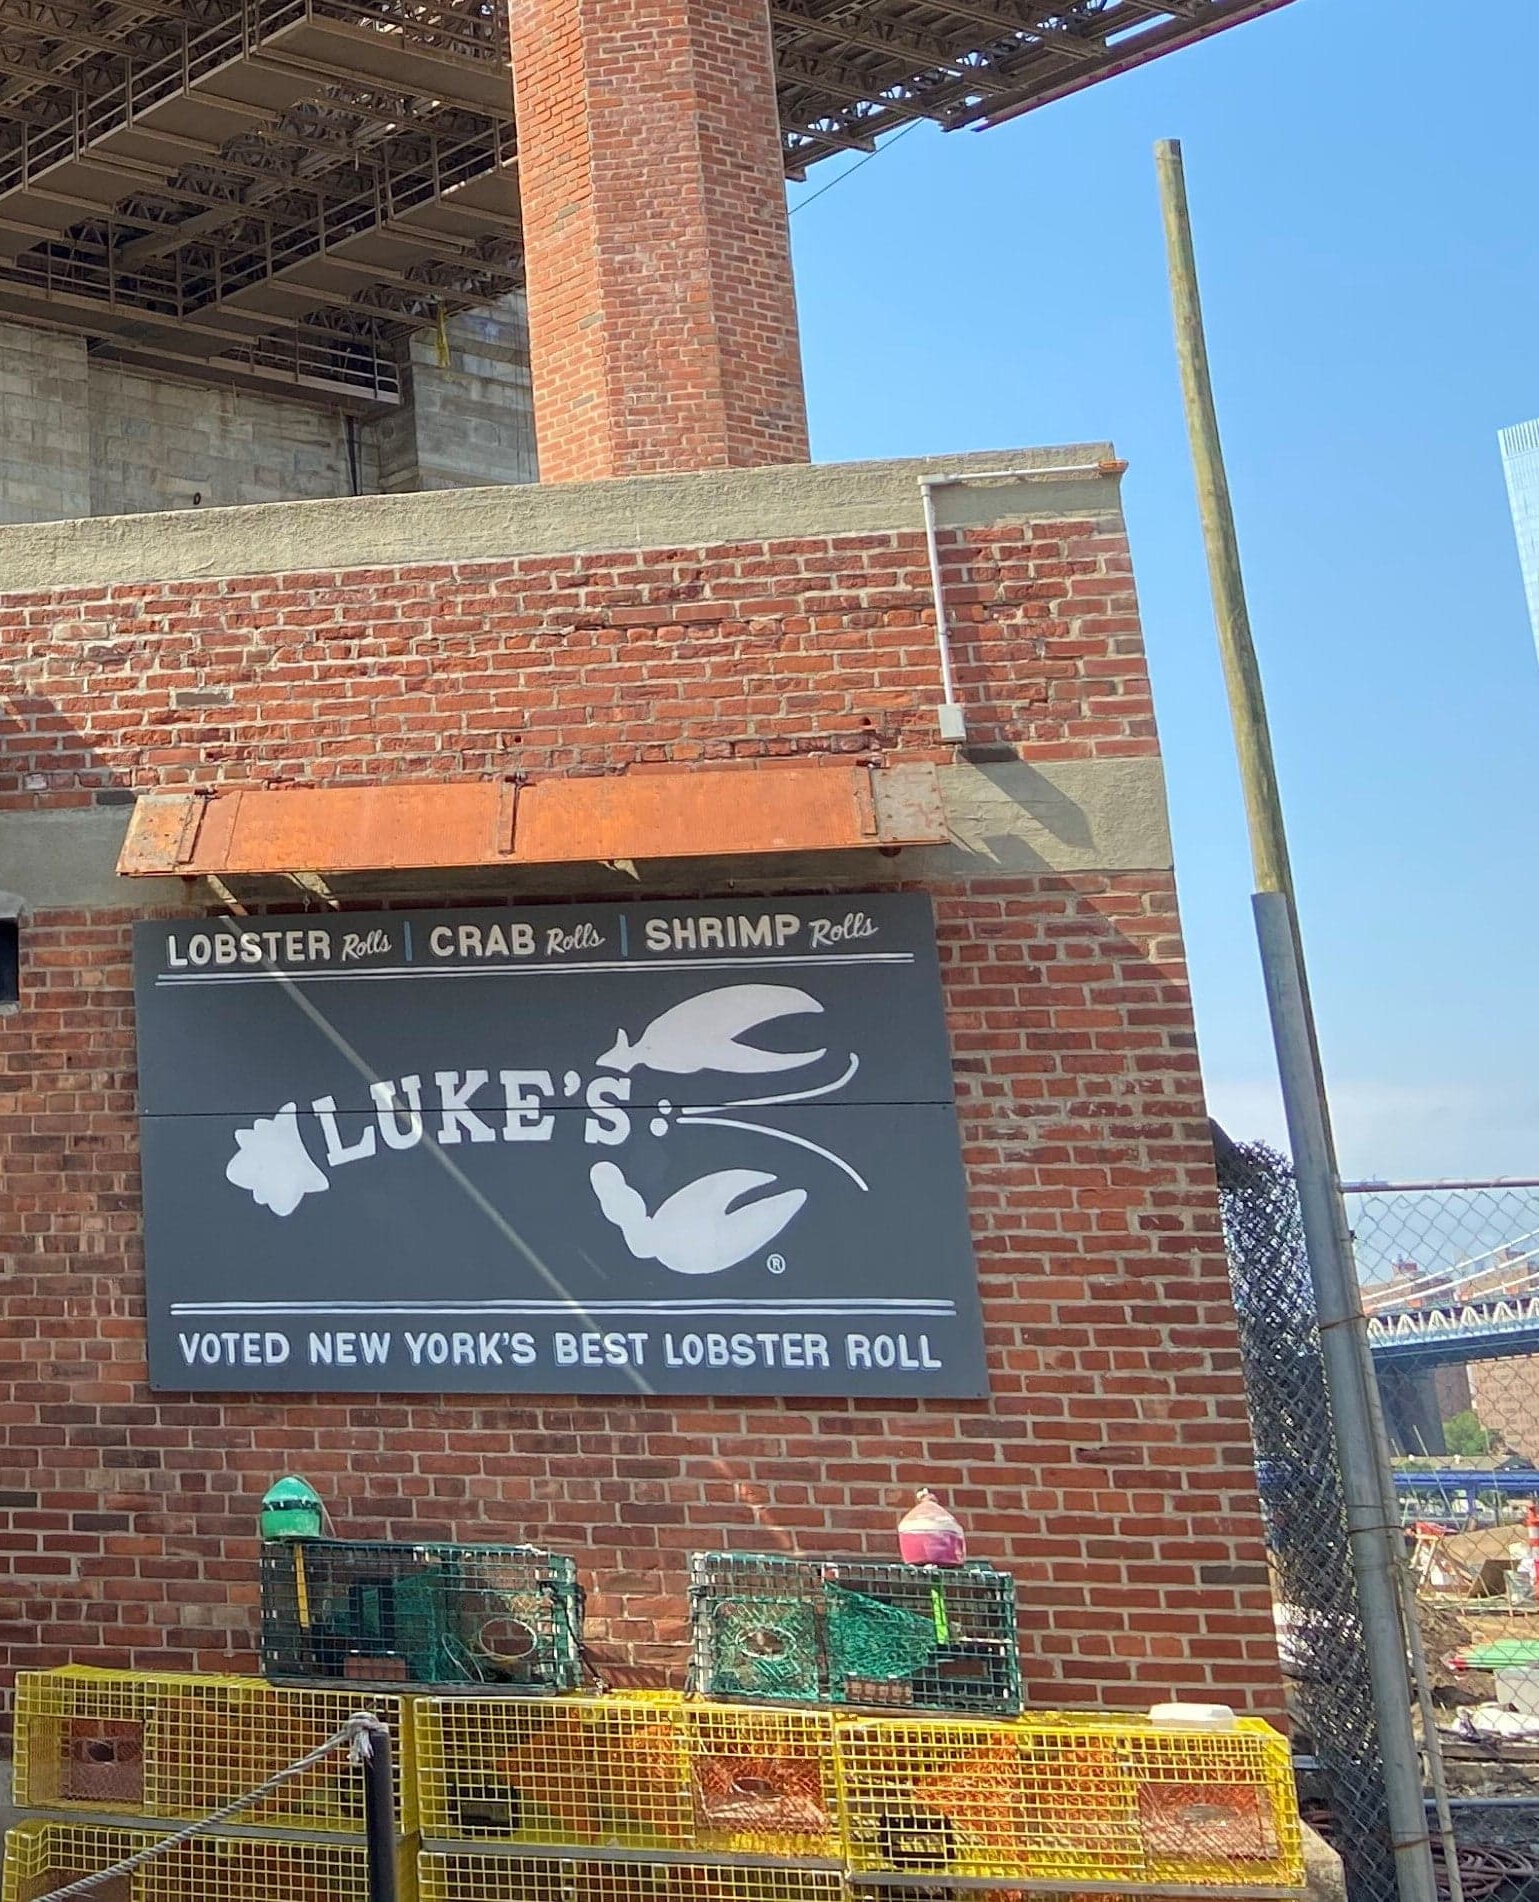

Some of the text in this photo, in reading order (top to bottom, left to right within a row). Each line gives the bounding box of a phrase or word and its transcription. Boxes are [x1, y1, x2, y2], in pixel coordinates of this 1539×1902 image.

[167, 911, 880, 967] LOBSTER Rolls CRAB Rolls SHRIMP Rolls
[314, 1067, 634, 1167] LUKE'S
[178, 1330, 942, 1369] VOTED NEW YORK'S BEST LOBSTER ROLL
